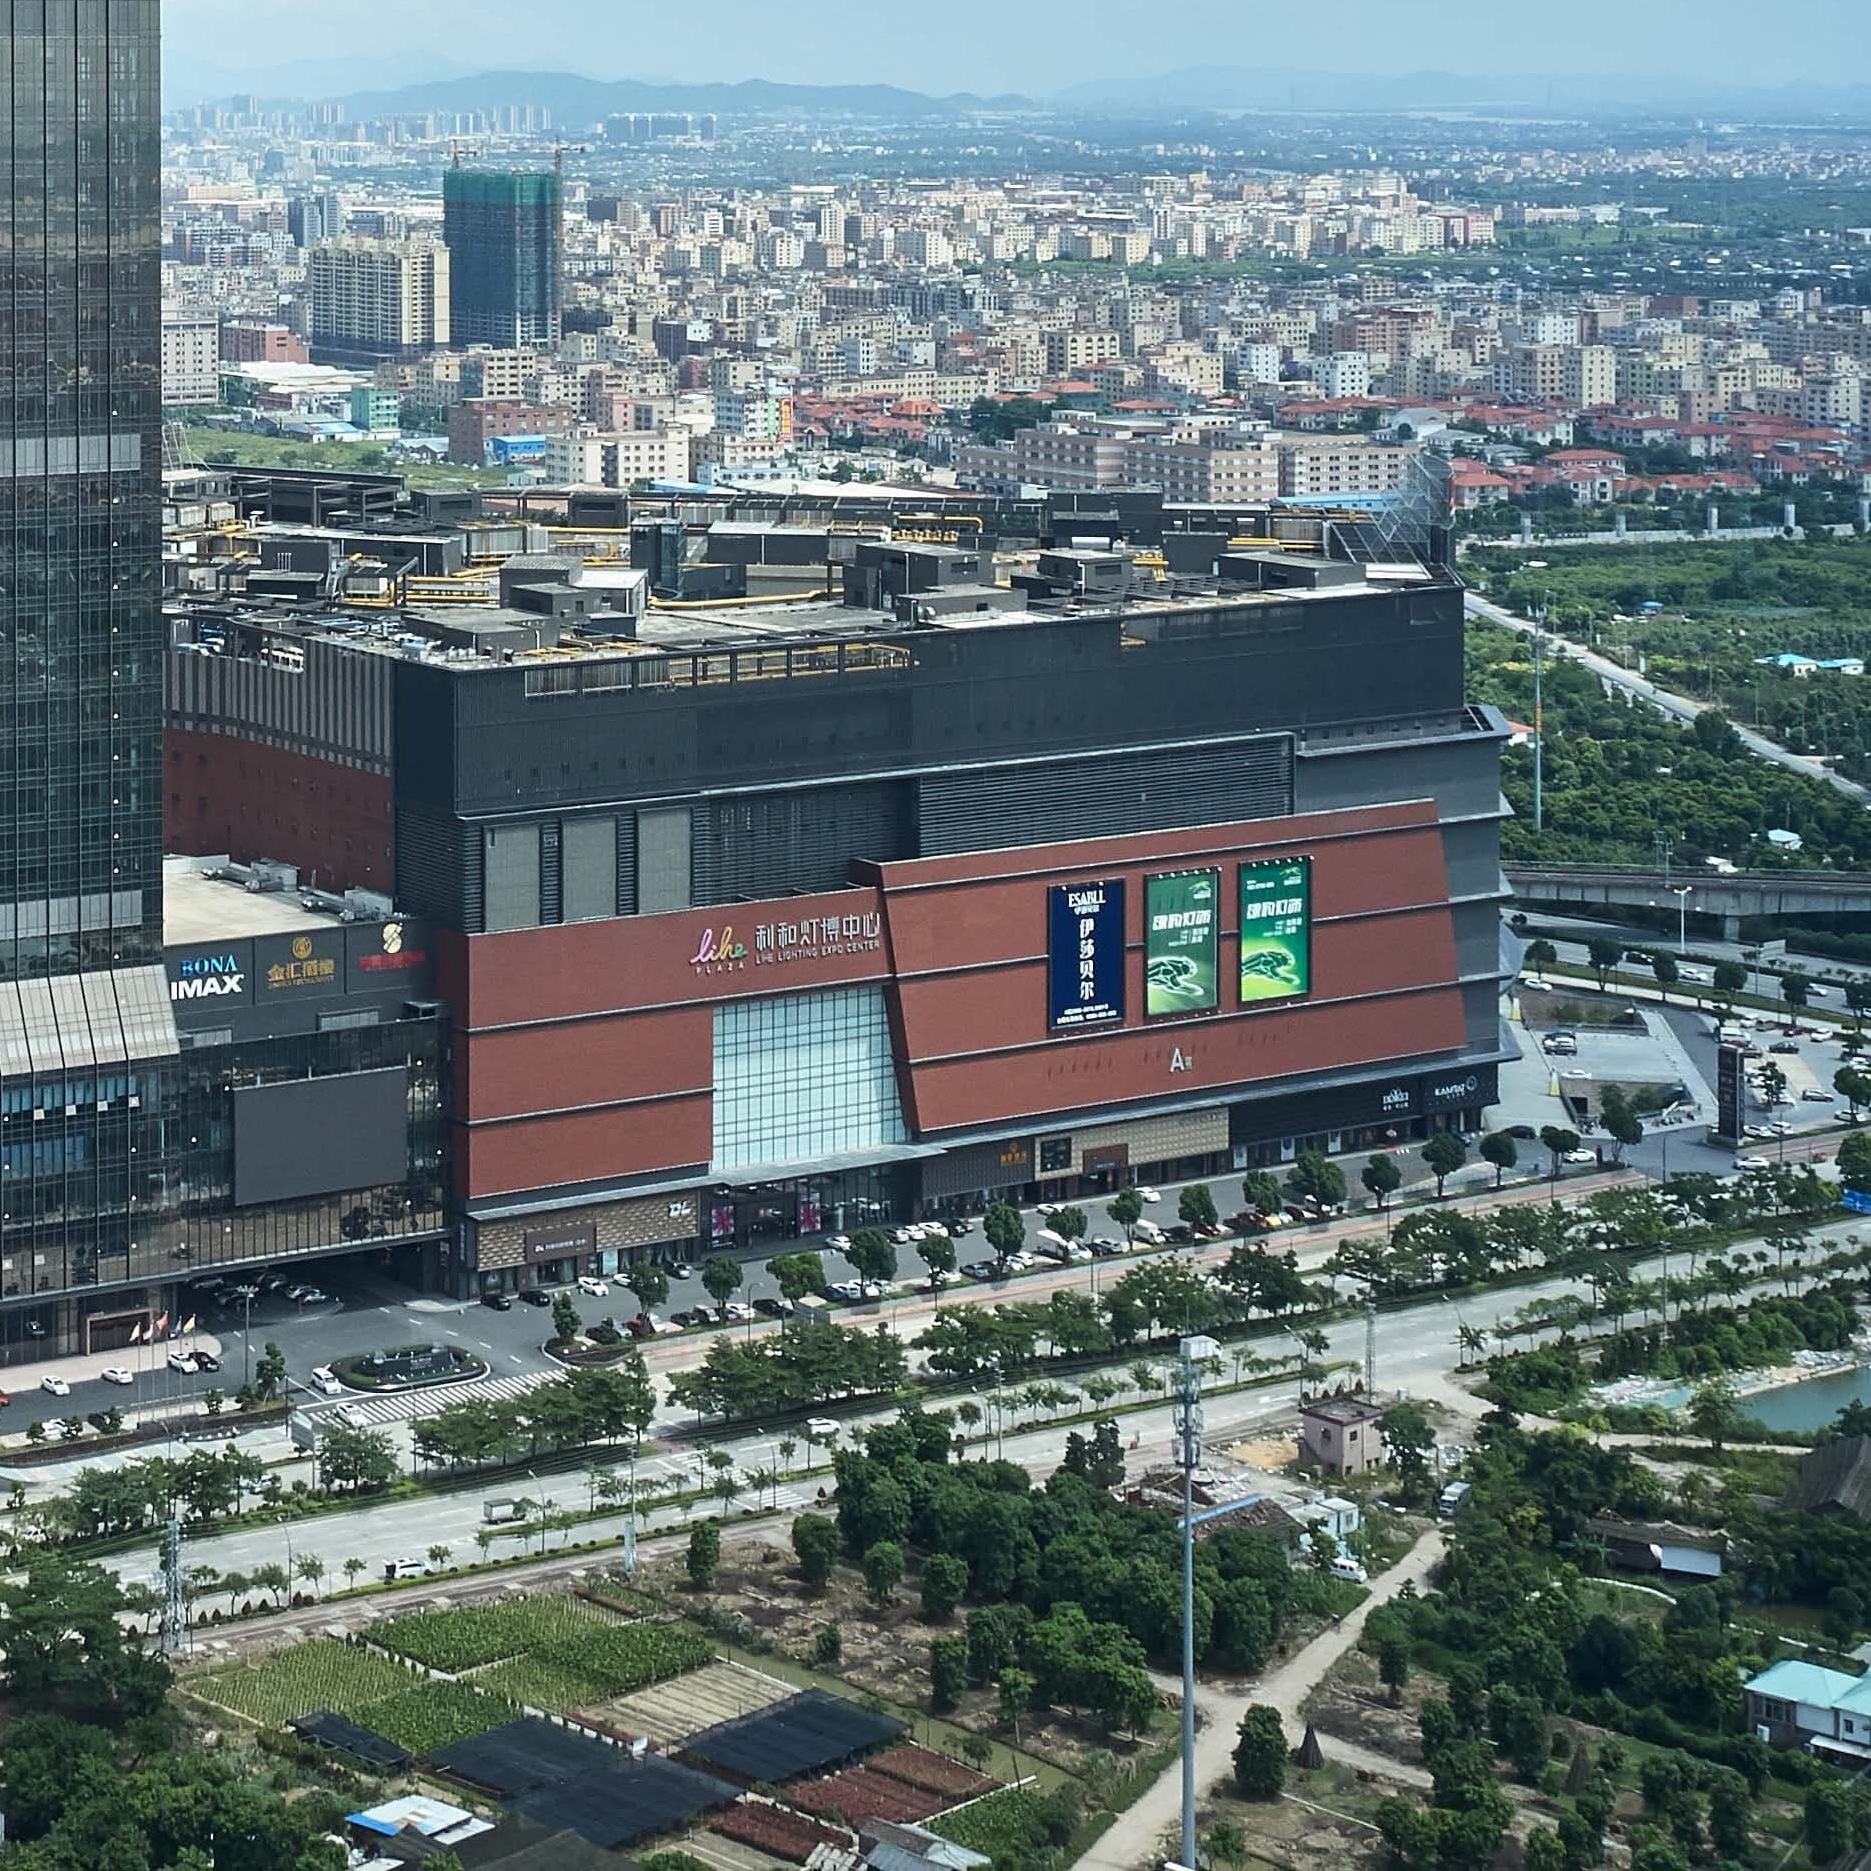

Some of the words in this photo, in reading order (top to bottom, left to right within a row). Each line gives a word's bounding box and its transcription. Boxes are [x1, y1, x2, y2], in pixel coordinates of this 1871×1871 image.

[778, 946, 818, 962] LIGHTING
[821, 943, 843, 957] EXPO
[846, 939, 880, 953] CENTER
[181, 954, 238, 977] BONA
[696, 962, 745, 976] PLAZA
[171, 975, 244, 1001] IMAX
